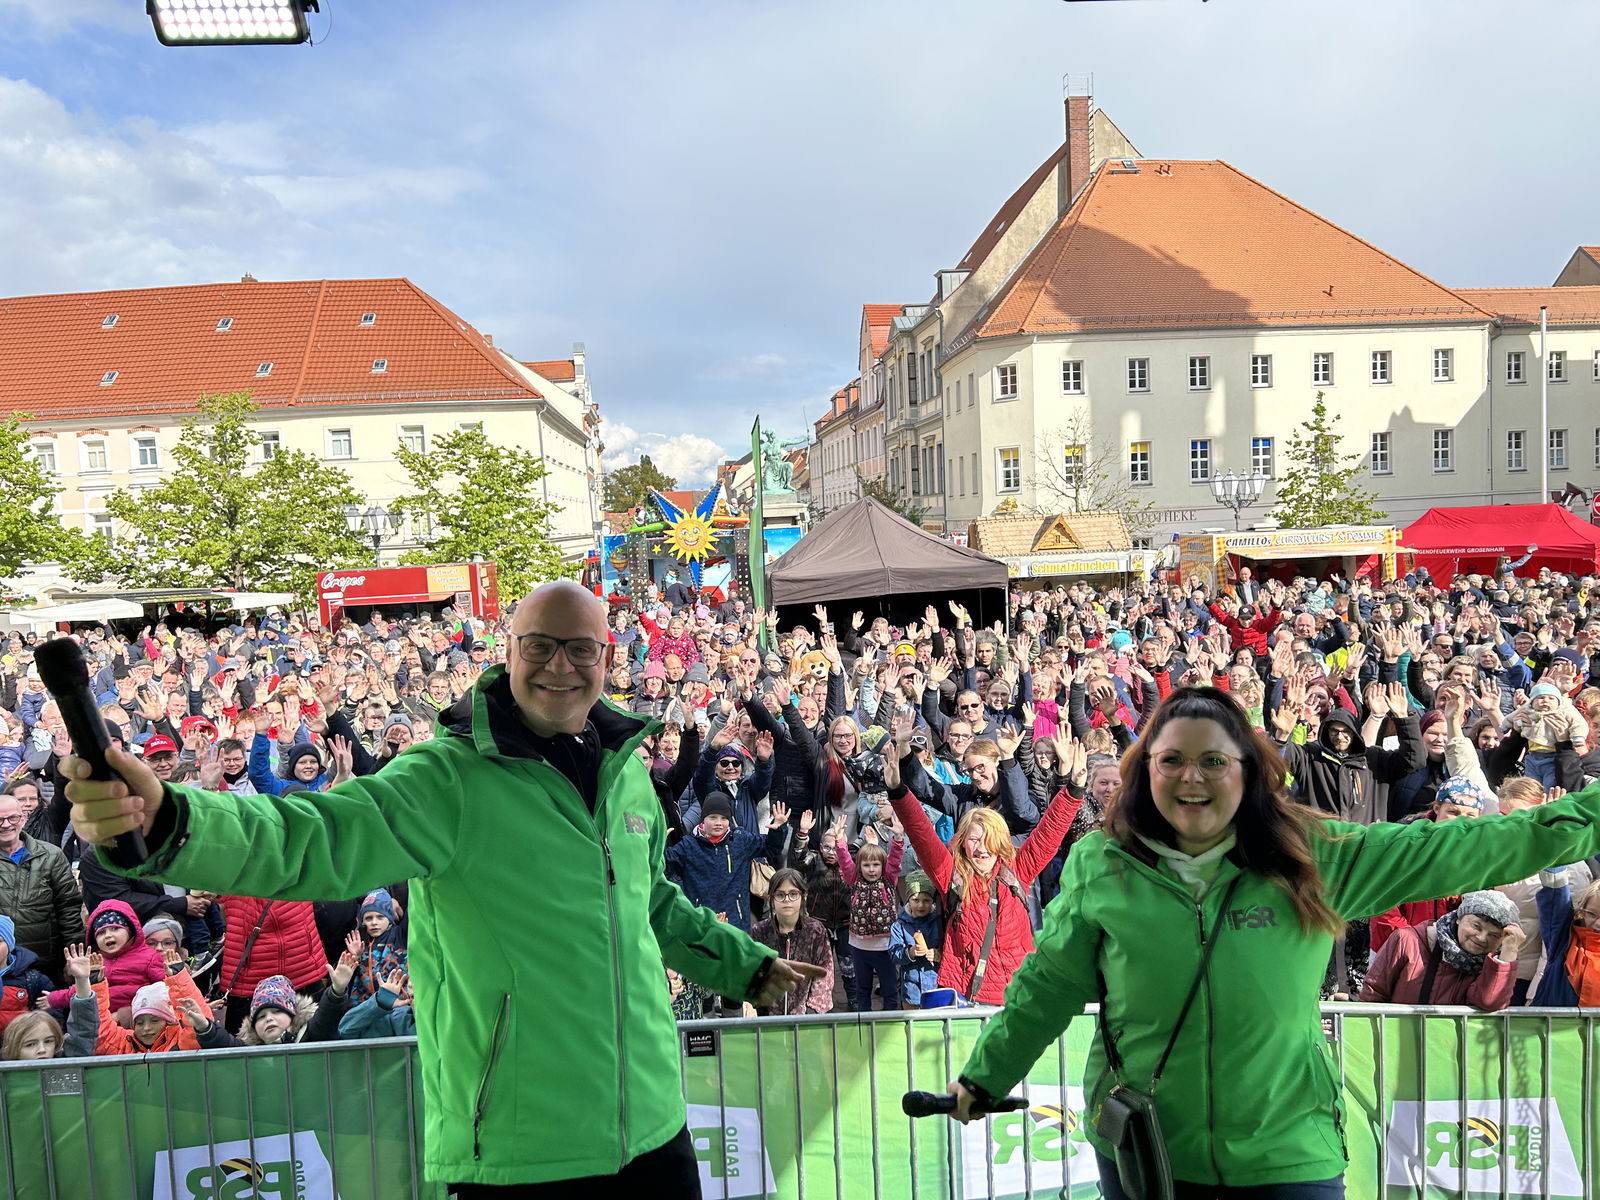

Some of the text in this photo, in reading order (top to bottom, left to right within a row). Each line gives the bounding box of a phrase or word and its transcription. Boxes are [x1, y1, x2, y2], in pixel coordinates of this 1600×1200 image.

[1275, 533, 1334, 545] CURRYWURST
[1347, 531, 1385, 541] POMMES
[1032, 560, 1117, 574] Schmalzkuchen
